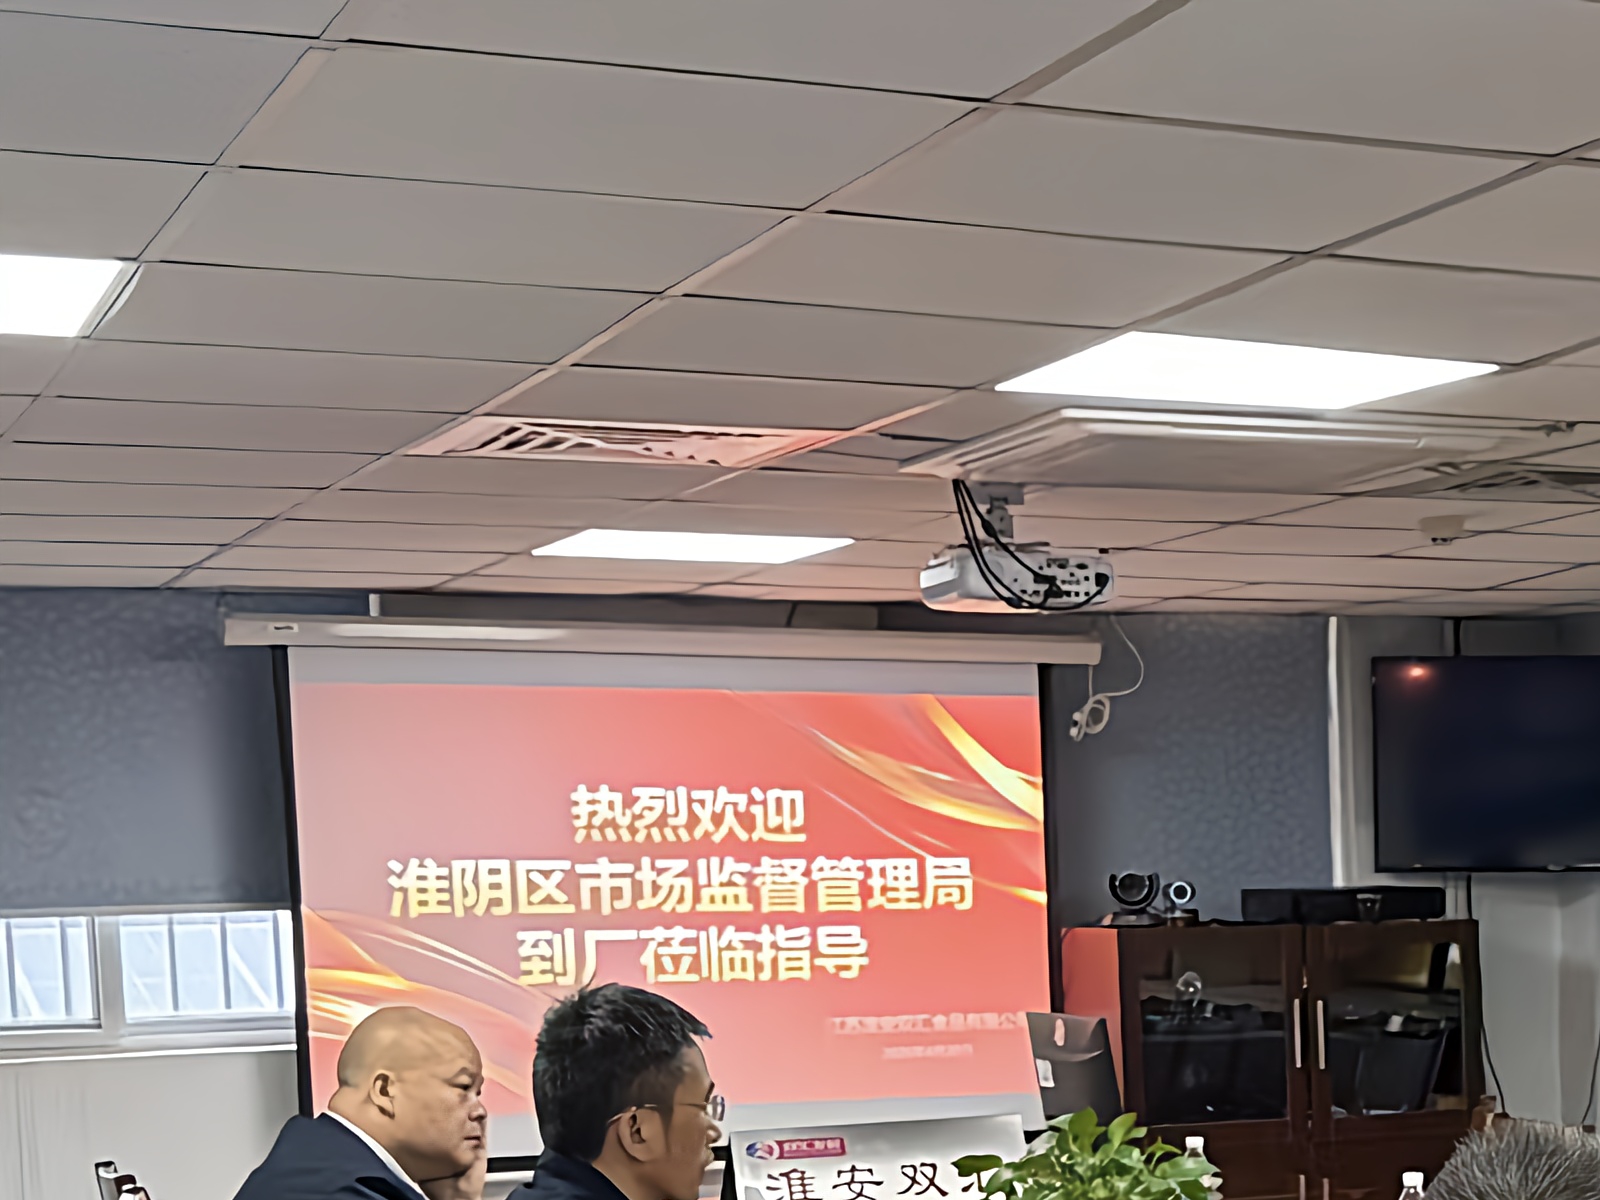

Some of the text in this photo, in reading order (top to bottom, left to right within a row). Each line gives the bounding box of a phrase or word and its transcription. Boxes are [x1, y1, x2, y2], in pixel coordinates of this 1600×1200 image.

[569, 783, 807, 844] 热烈欢迎
[386, 855, 974, 919] 淮阴区市场监督管理局
[516, 923, 869, 987] 到厂莅临指导
